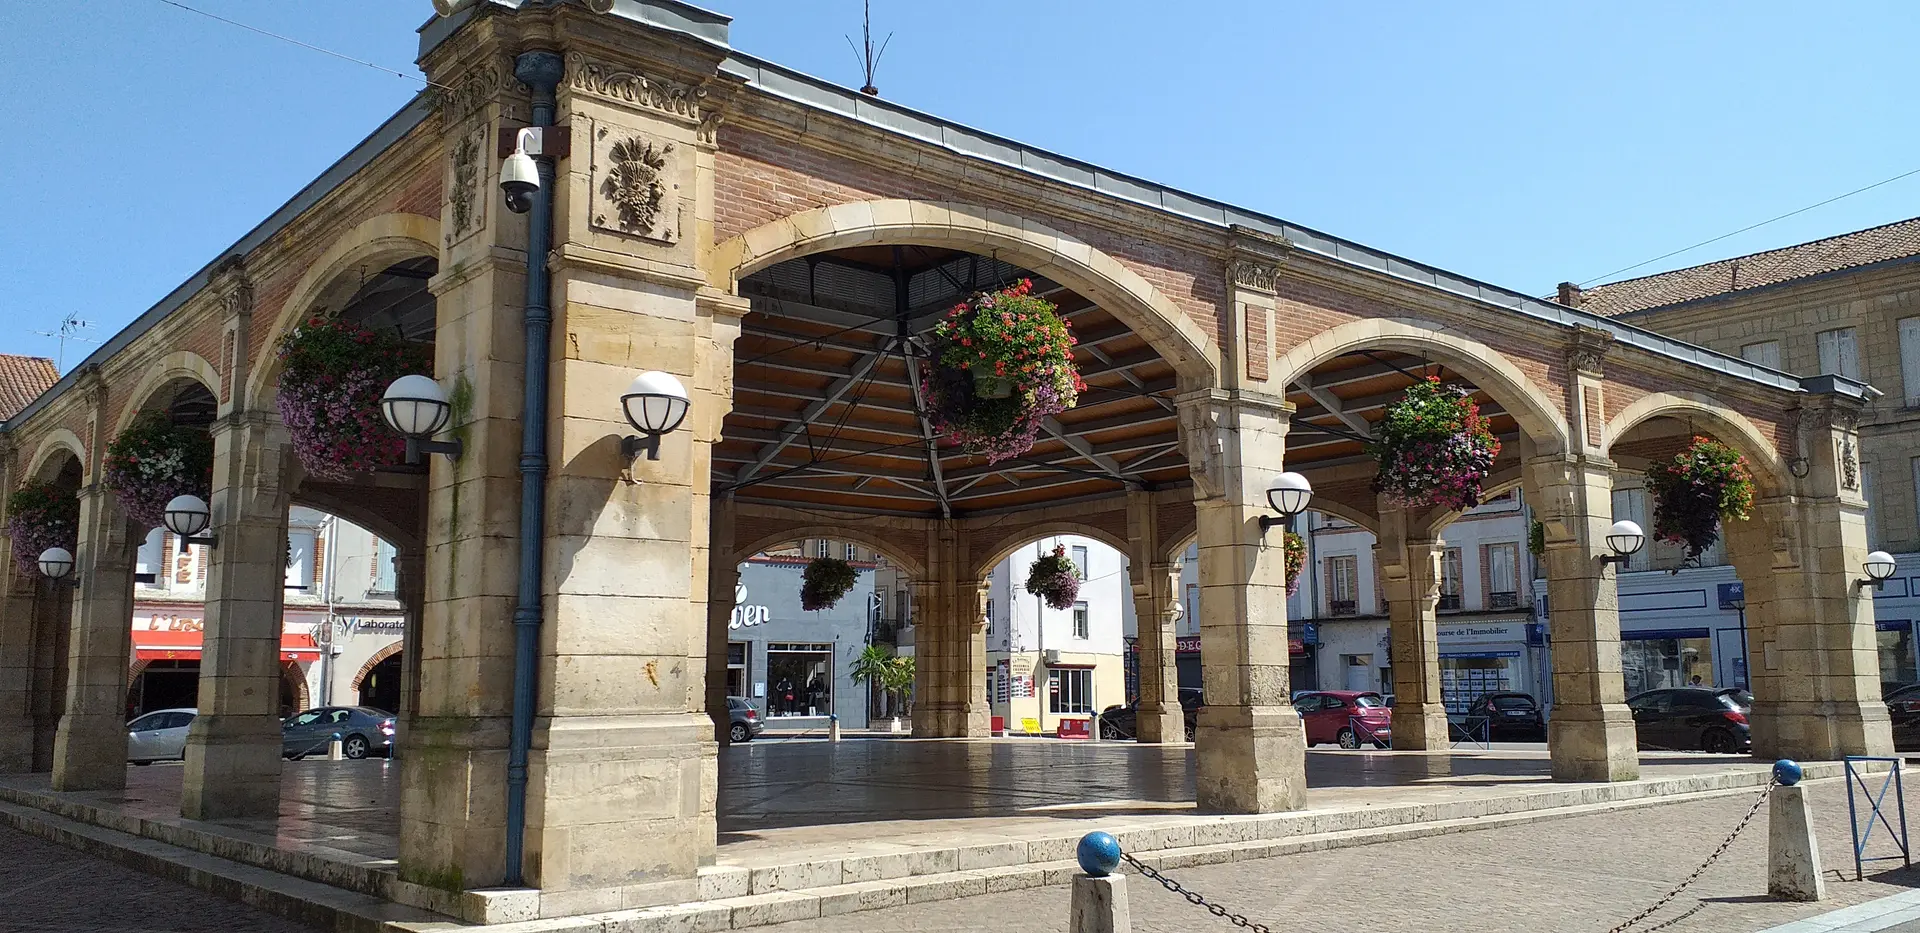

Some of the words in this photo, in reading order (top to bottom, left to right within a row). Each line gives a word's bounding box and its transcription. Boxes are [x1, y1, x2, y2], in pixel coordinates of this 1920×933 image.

[728, 604, 771, 630] ven
[1436, 629, 1455, 637] ourse
[1457, 628, 1465, 636] de
[1466, 627, 1508, 636] l'Immobilier
